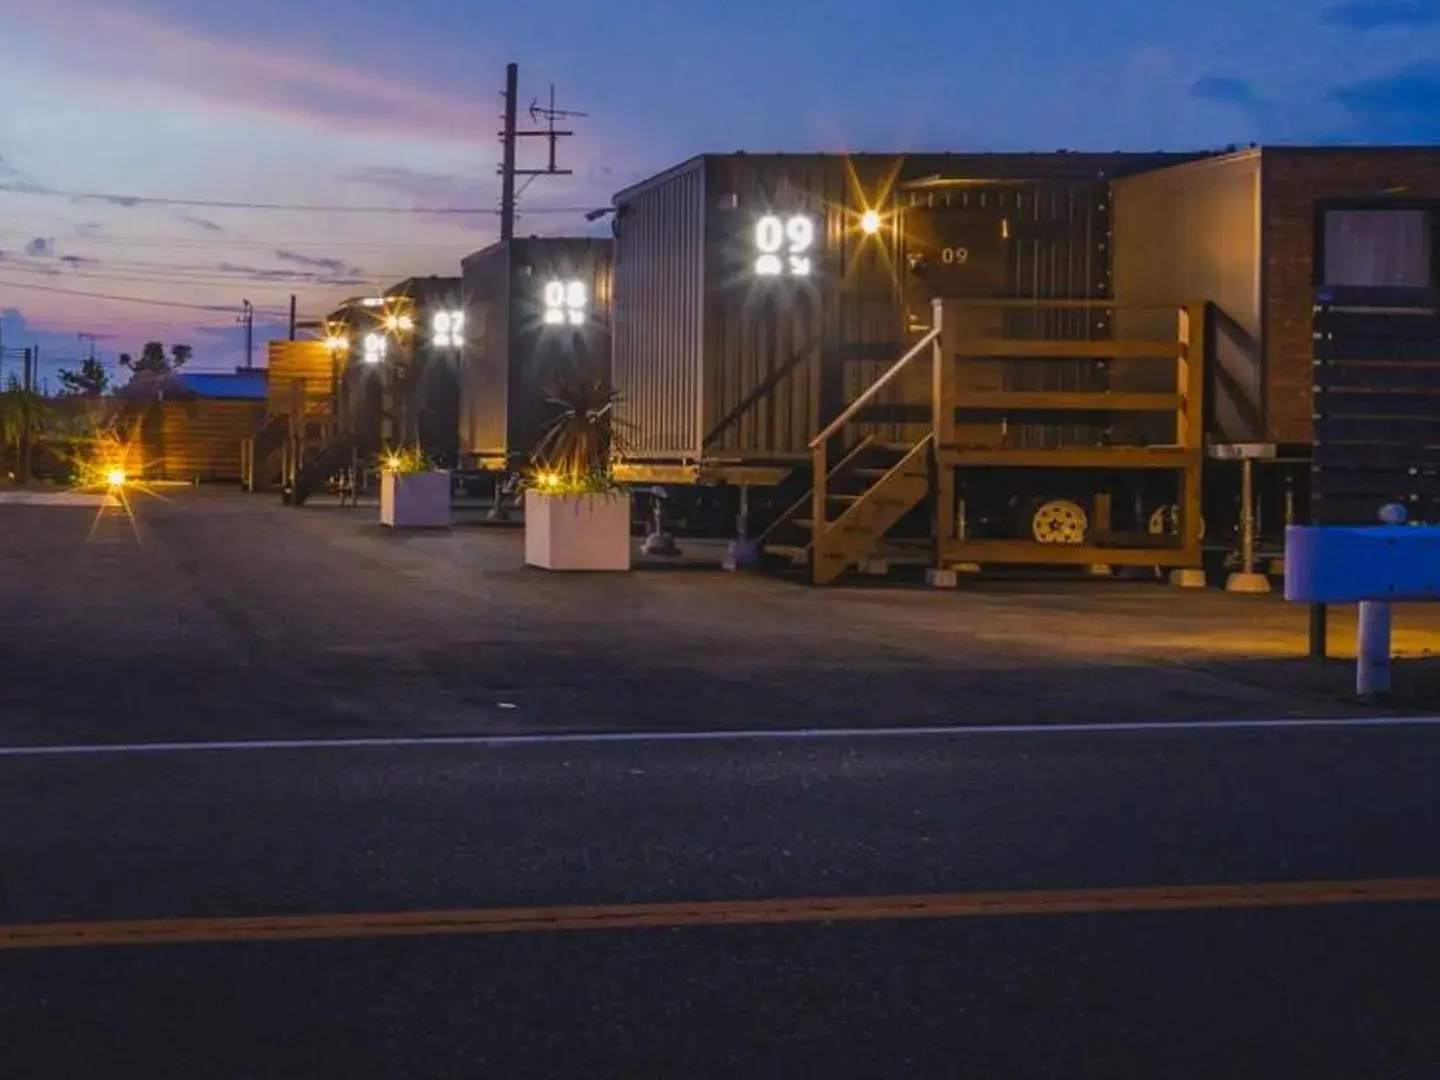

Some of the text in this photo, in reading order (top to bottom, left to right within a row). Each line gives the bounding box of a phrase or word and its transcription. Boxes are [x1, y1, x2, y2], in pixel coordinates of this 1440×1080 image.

[756, 216, 814, 252] 09
[942, 247, 968, 263] 09
[434, 311, 464, 332] 07
